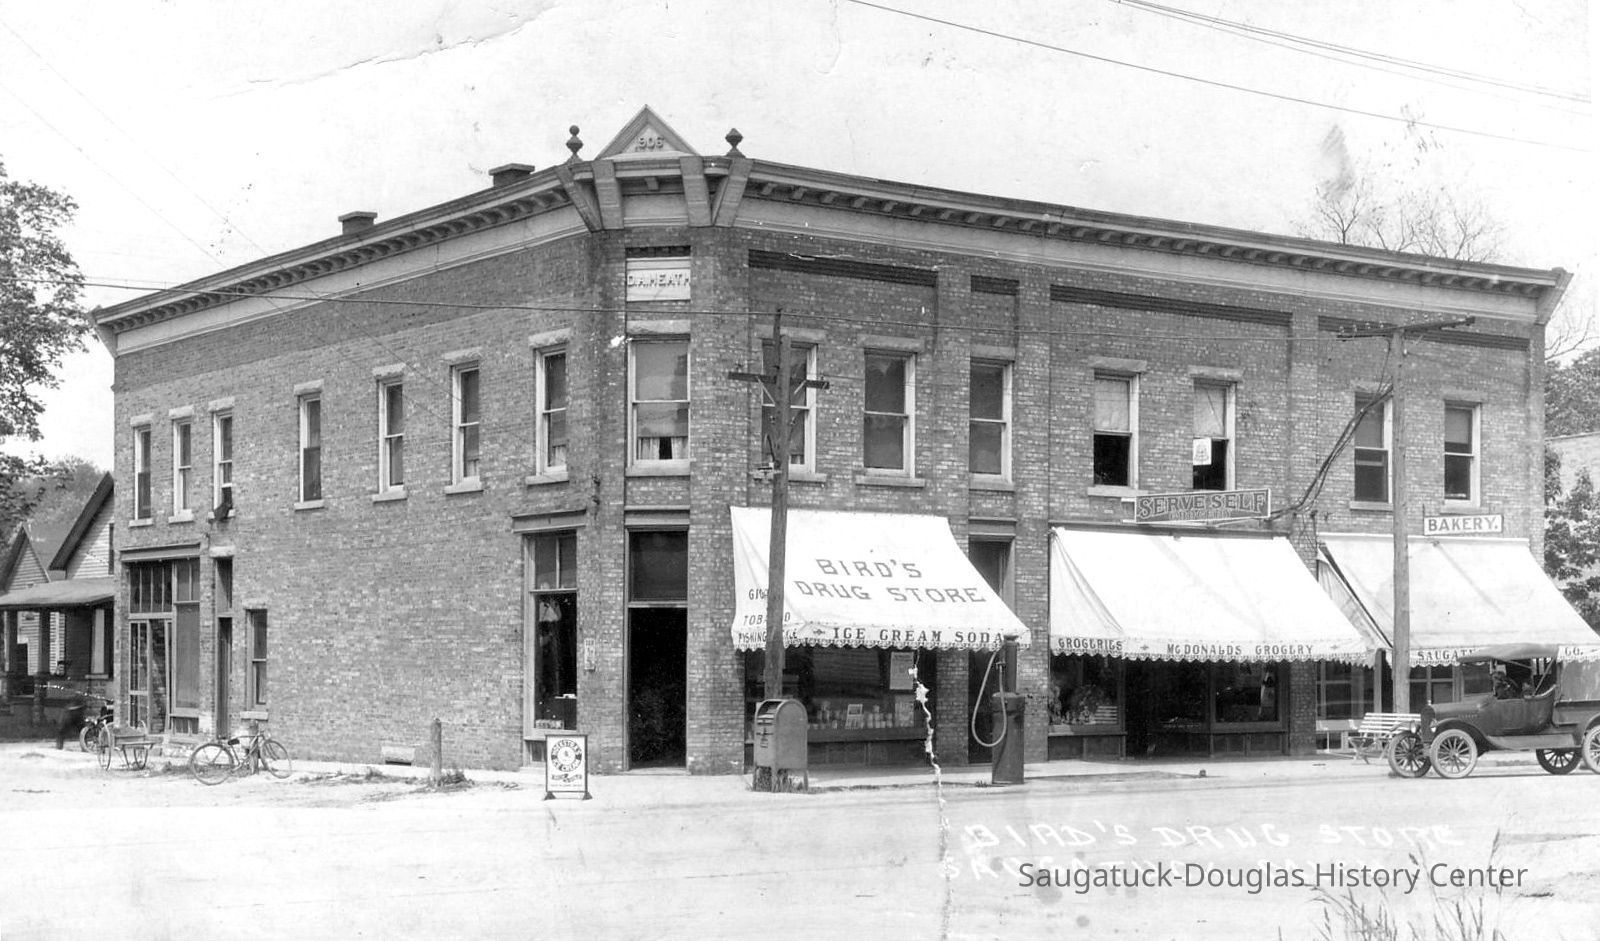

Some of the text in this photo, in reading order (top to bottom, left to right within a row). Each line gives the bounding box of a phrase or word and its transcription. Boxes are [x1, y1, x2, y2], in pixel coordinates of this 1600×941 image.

[1139, 494, 1206, 519] SERVE
[1211, 492, 1266, 514] SELF
[1428, 518, 1500, 532] BAKERY.
[815, 558, 922, 578] BIRD'S
[794, 580, 986, 602] DRUG STORE
[743, 611, 791, 626] TOBO
[833, 627, 866, 640] ICE
[879, 628, 942, 642] CREAM
